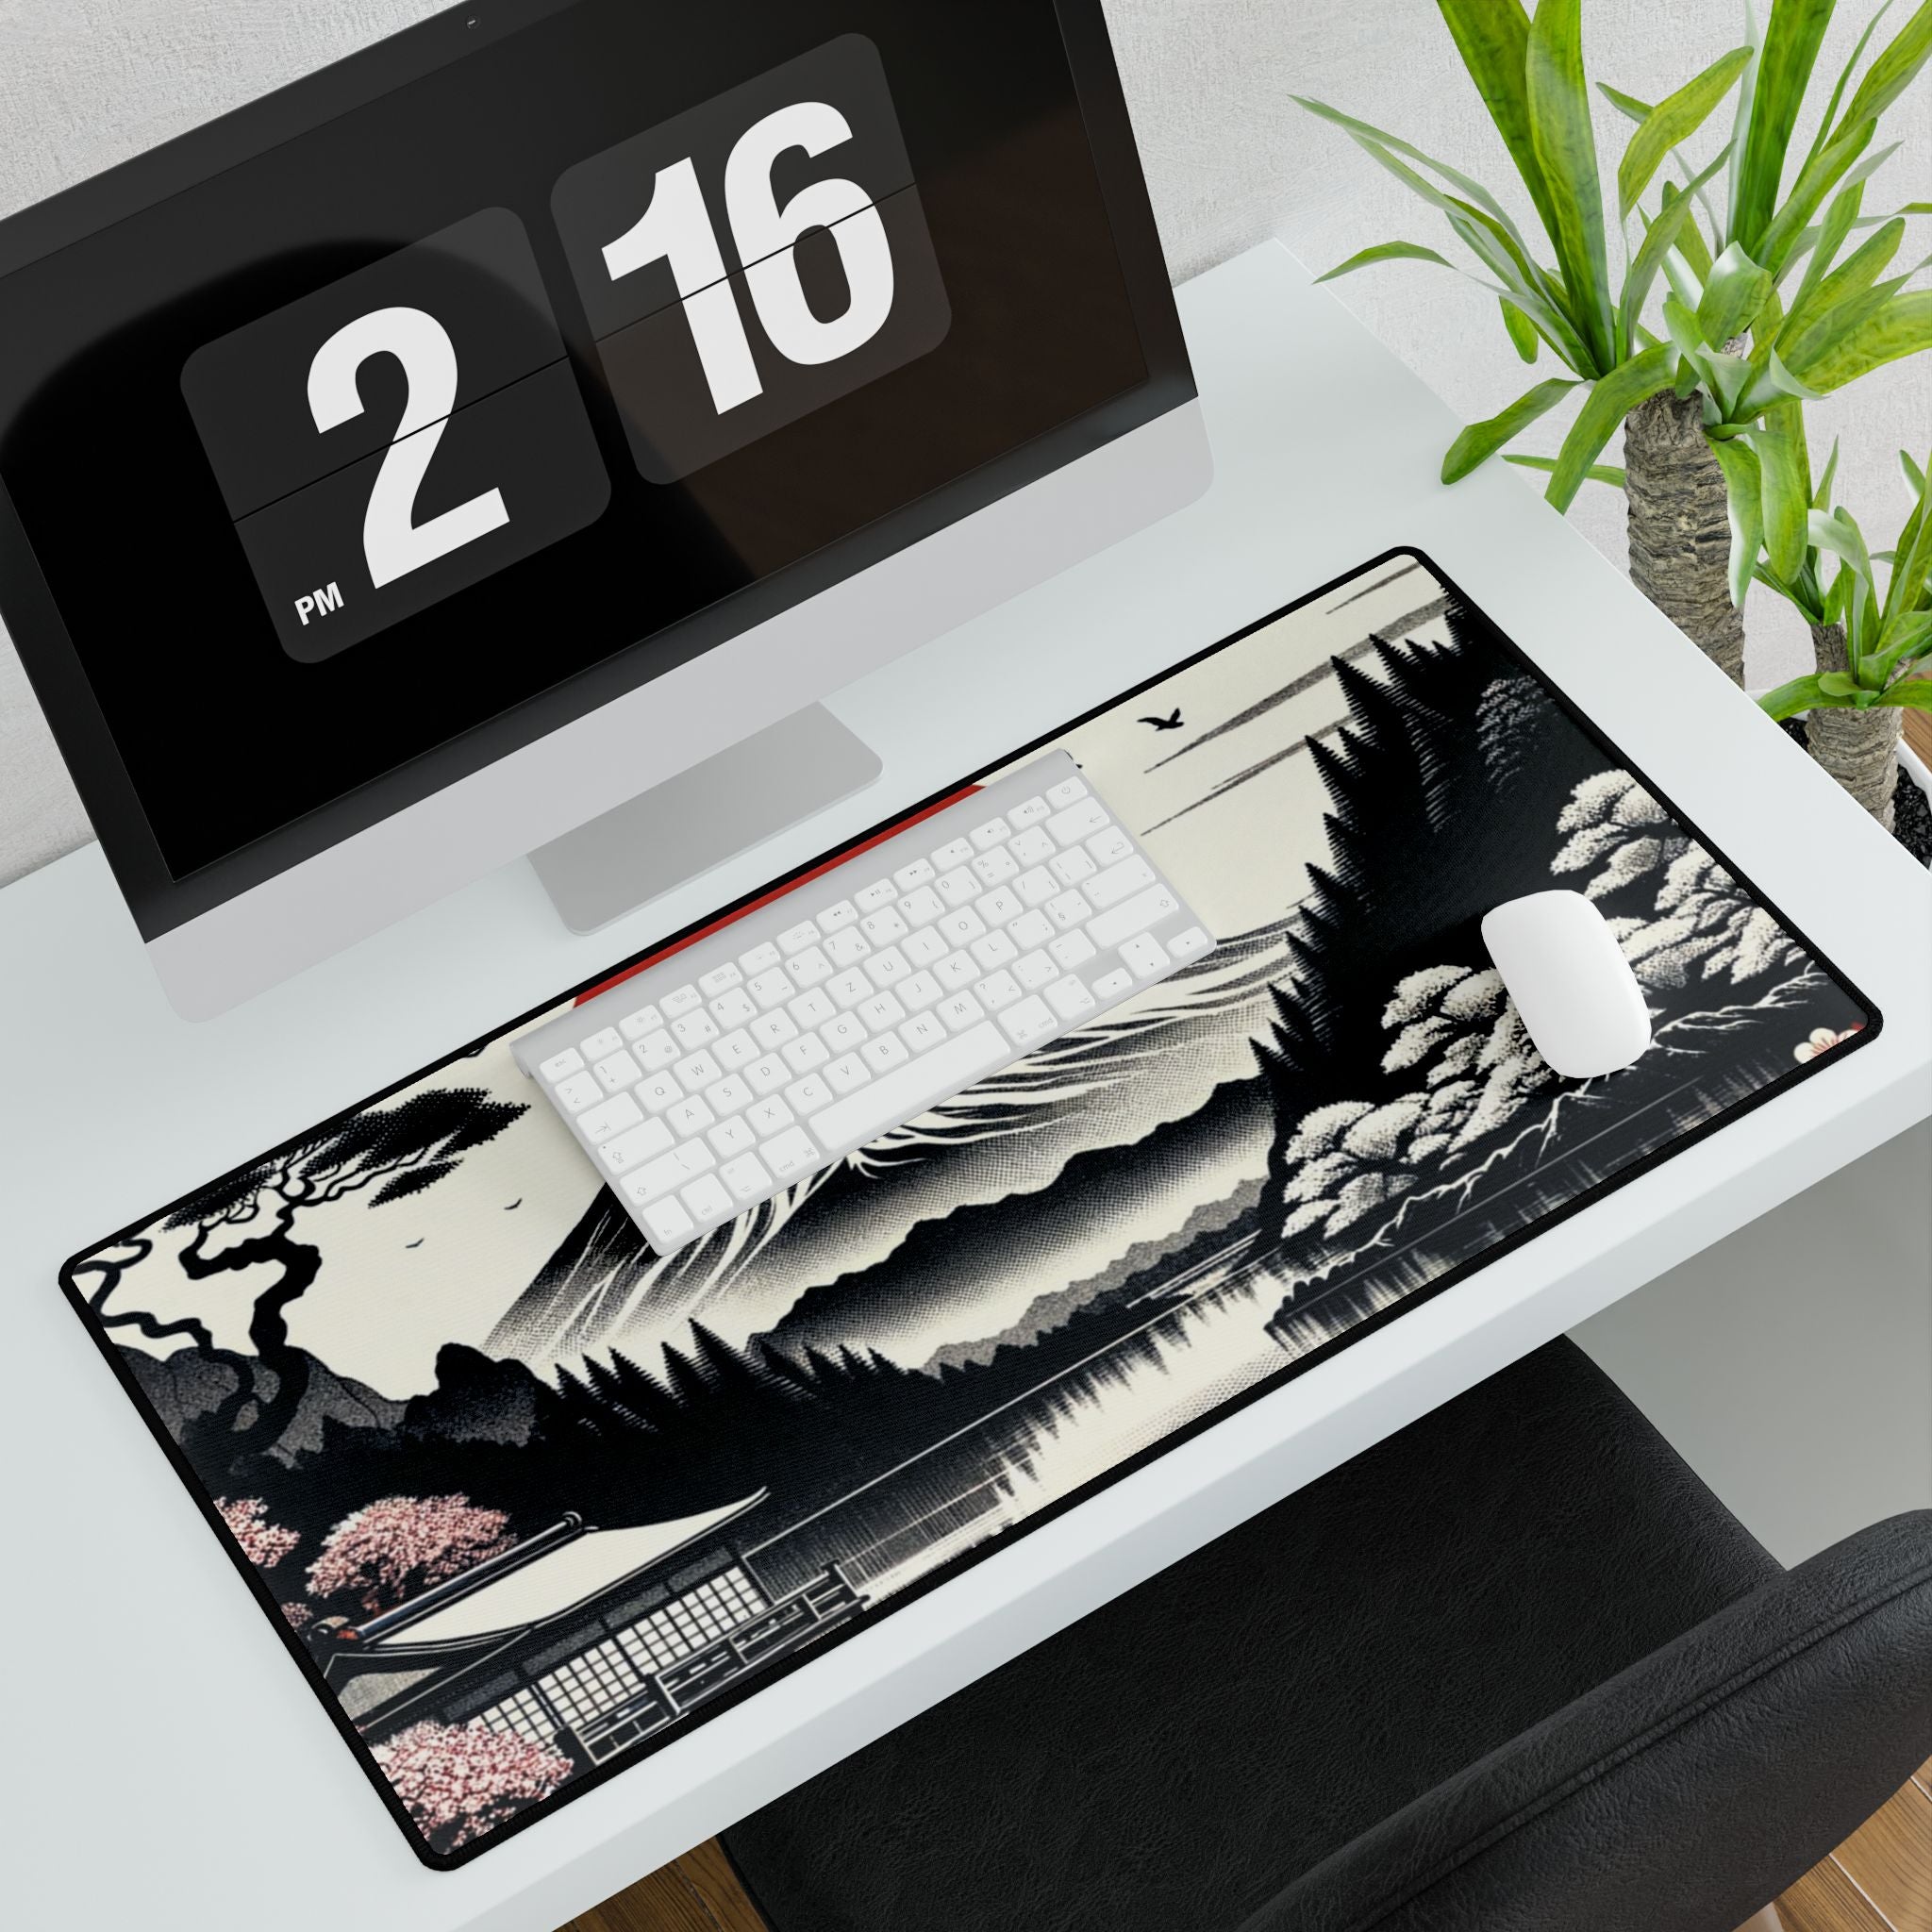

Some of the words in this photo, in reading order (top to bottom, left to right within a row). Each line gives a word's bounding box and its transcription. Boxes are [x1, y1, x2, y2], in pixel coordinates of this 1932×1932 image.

[307, 307, 510, 590] 2
[601, 101, 894, 415] 16
[294, 581, 344, 626] PM
[639, 1043, 648, 1055] 2
[676, 1023, 687, 1035] 3
[717, 1002, 725, 1012] 4
[754, 981, 763, 991] 5
[792, 960, 801, 972] 6
[827, 941, 837, 951] 7
[866, 921, 876, 930] 8
[903, 900, 912, 910] 9
[976, 859, 990, 869] %
[654, 1086, 667, 1096] Q
[691, 1063, 705, 1076] W
[731, 1043, 742, 1056] E
[769, 1024, 781, 1035] R
[807, 1002, 818, 1013] T
[844, 981, 858, 993] Z
[882, 960, 894, 973] U
[958, 921, 969, 931] O
[994, 899, 1005, 912] P
[685, 1108, 695, 1120] A
[722, 1087, 733, 1098] S
[759, 1066, 772, 1078] D
[799, 1044, 808, 1056] F
[837, 1024, 848, 1035] G
[874, 1003, 887, 1015] H
[914, 982, 923, 993] J
[949, 961, 962, 974] K
[988, 942, 999, 953] L
[1038, 1016, 1055, 1029] cmd
[724, 1127, 735, 1140] Y
[762, 1107, 776, 1119] X
[803, 1086, 814, 1097] C
[839, 1065, 850, 1076] V
[877, 1043, 890, 1056] B
[915, 1023, 929, 1035] N
[953, 1003, 967, 1015] M
[778, 1159, 795, 1173] cmd
